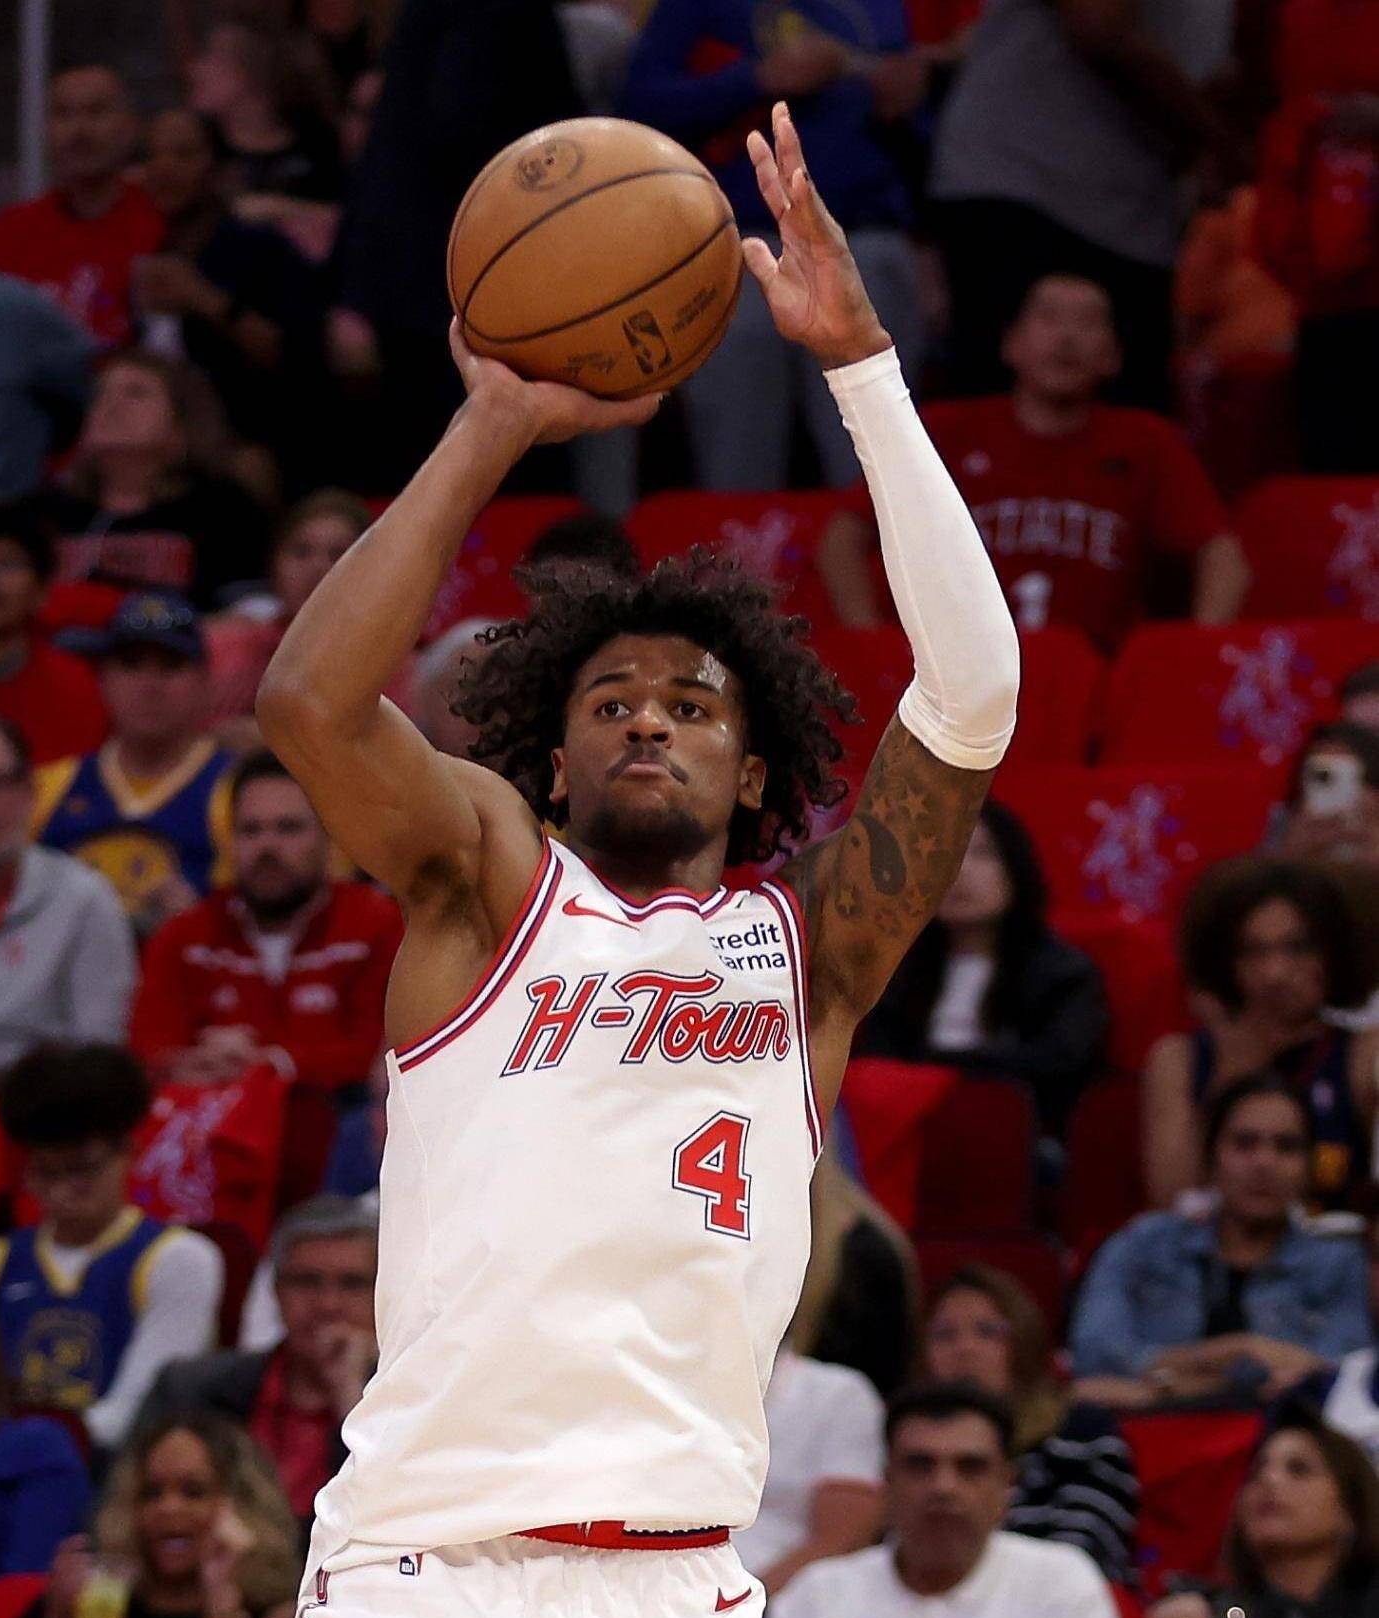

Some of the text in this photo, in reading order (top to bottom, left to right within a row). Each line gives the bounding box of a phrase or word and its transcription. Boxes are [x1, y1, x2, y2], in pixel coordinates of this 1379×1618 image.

[718, 952, 787, 971] arma
[499, 968, 791, 1078] H-Town
[672, 1110, 752, 1241] 4
